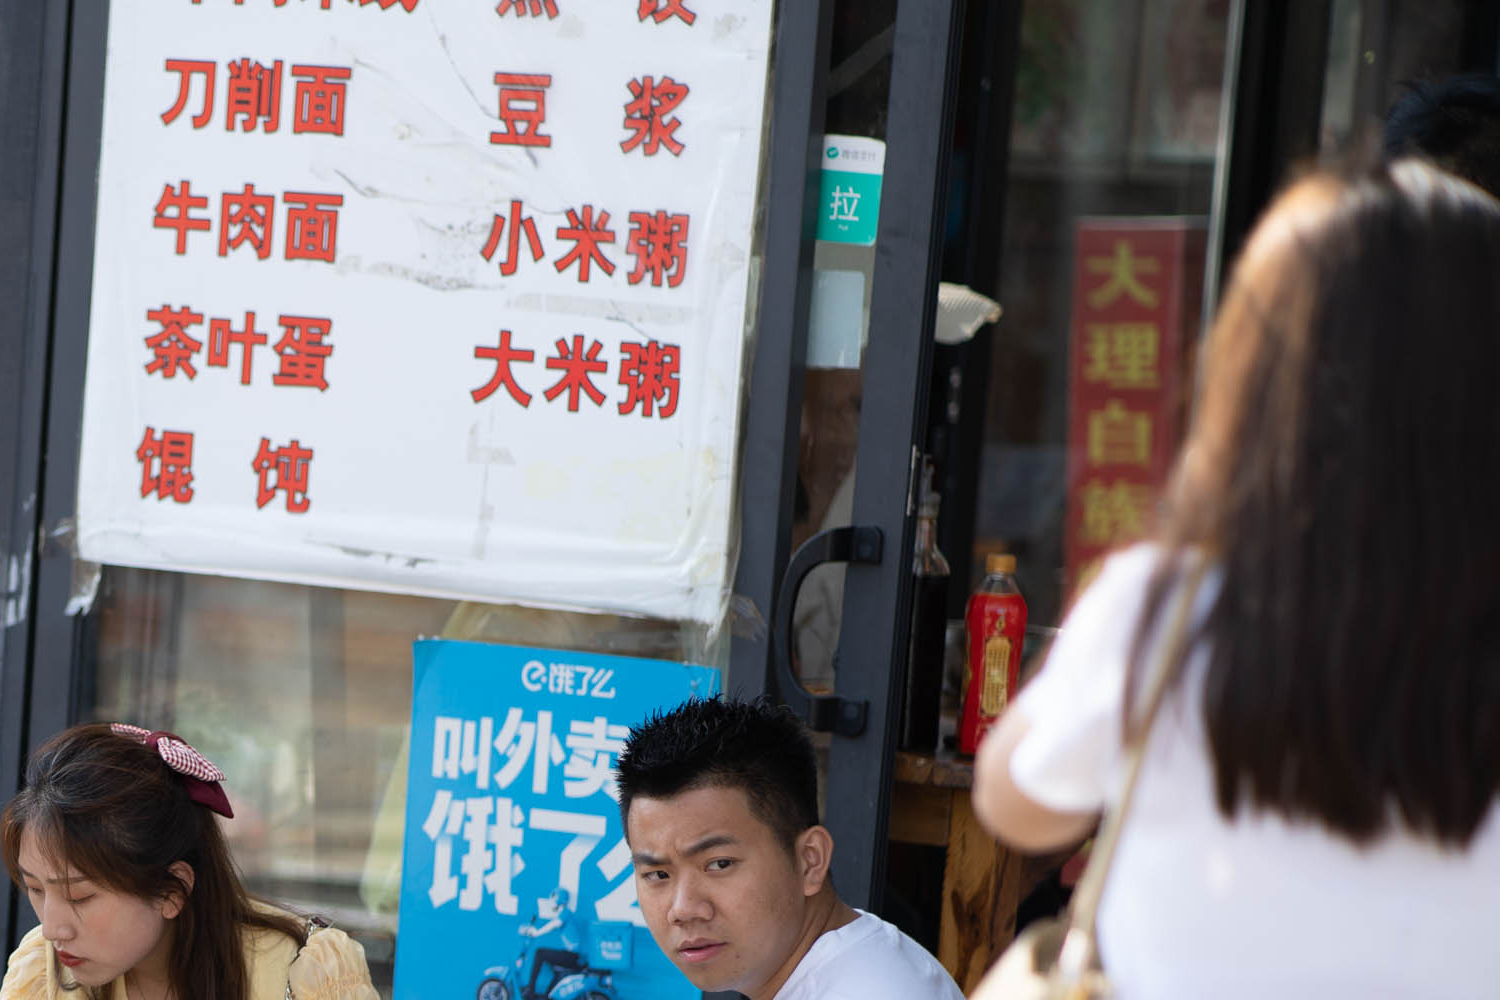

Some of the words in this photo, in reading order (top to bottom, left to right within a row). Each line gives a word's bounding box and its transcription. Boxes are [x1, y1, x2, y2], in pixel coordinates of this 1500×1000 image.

[161, 58, 352, 136] 刀削面
[490, 72, 690, 157] 豆浆
[153, 180, 344, 262] 牛肉面
[481, 200, 690, 288] 小米粥
[829, 185, 861, 222] 拉
[145, 305, 334, 391] 茶叶蛋
[471, 330, 681, 419] 大米粥
[1078, 240, 1164, 596] 大理白族
[136, 427, 313, 514] 馄饨
[548, 662, 616, 699] 饿了么
[431, 707, 631, 803] 叫外卖
